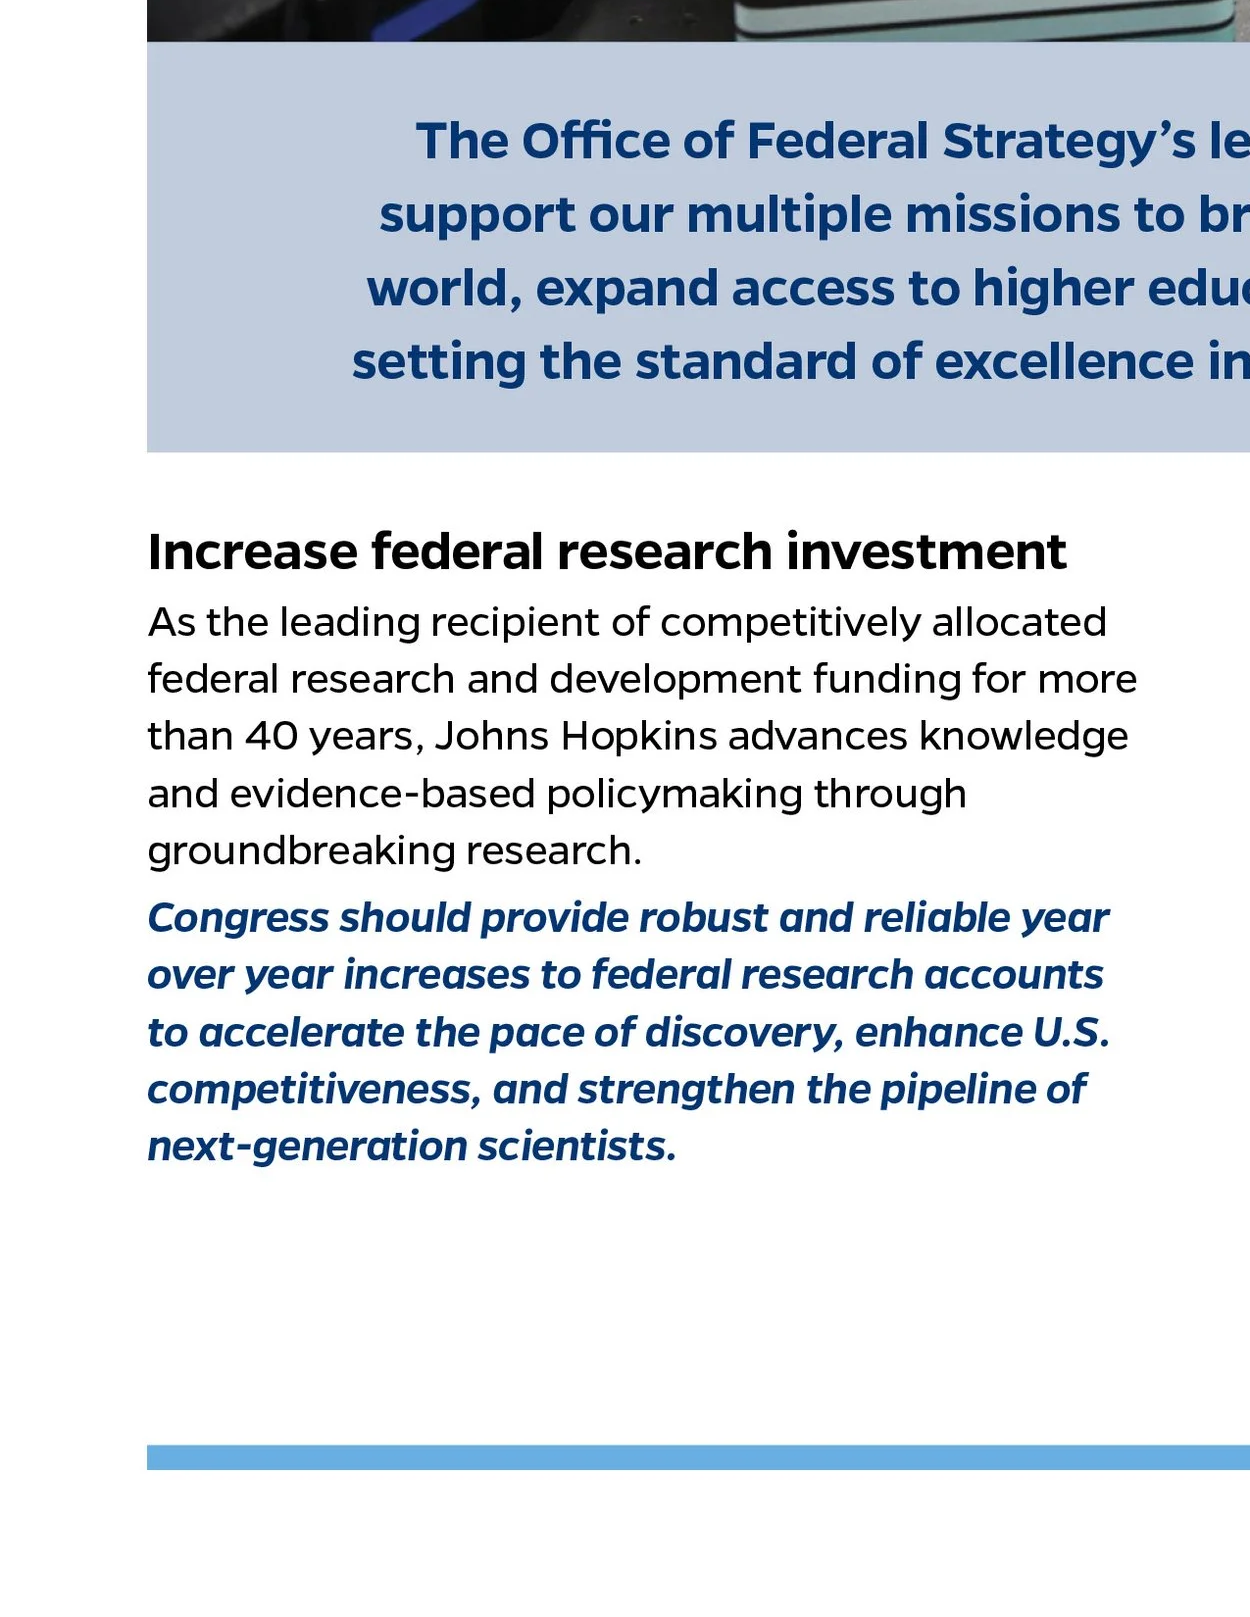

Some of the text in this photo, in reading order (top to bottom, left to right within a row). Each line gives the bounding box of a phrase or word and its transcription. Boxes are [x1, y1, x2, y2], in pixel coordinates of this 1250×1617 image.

[415, 120, 509, 159] The
[522, 118, 671, 159] Office
[683, 118, 736, 159] of
[749, 120, 928, 159] Federal
[943, 119, 1196, 169] Strategy’s
[379, 197, 577, 241] support
[589, 203, 675, 233] our
[688, 191, 892, 241] multiple
[907, 191, 1121, 233] missions
[1133, 197, 1185, 233] to
[366, 267, 522, 314] world,
[536, 267, 718, 315] expand
[732, 276, 895, 307] access
[908, 270, 961, 307] to
[974, 265, 1136, 316] higher
[352, 338, 526, 390] setting
[539, 341, 622, 380] the
[635, 341, 856, 380] standard
[871, 339, 924, 380] of
[935, 341, 1194, 380] excellence
[150, 528, 1068, 570] Increase federal research investment
[147, 604, 1106, 645] As the leading recipient of competitively allocated
[147, 719, 1129, 758] than 40 years, Johns Hopkins advances knowledge
[148, 777, 966, 816] and evidence-based policymaking through
[148, 834, 641, 873] groundbreaking research.
[148, 899, 1112, 940] Congress should provide robust and reliable year
[147, 1013, 1109, 1055] to accelerate the pace of discovery, enhance U.S.
[147, 1127, 676, 1168] next-generation scientists.
